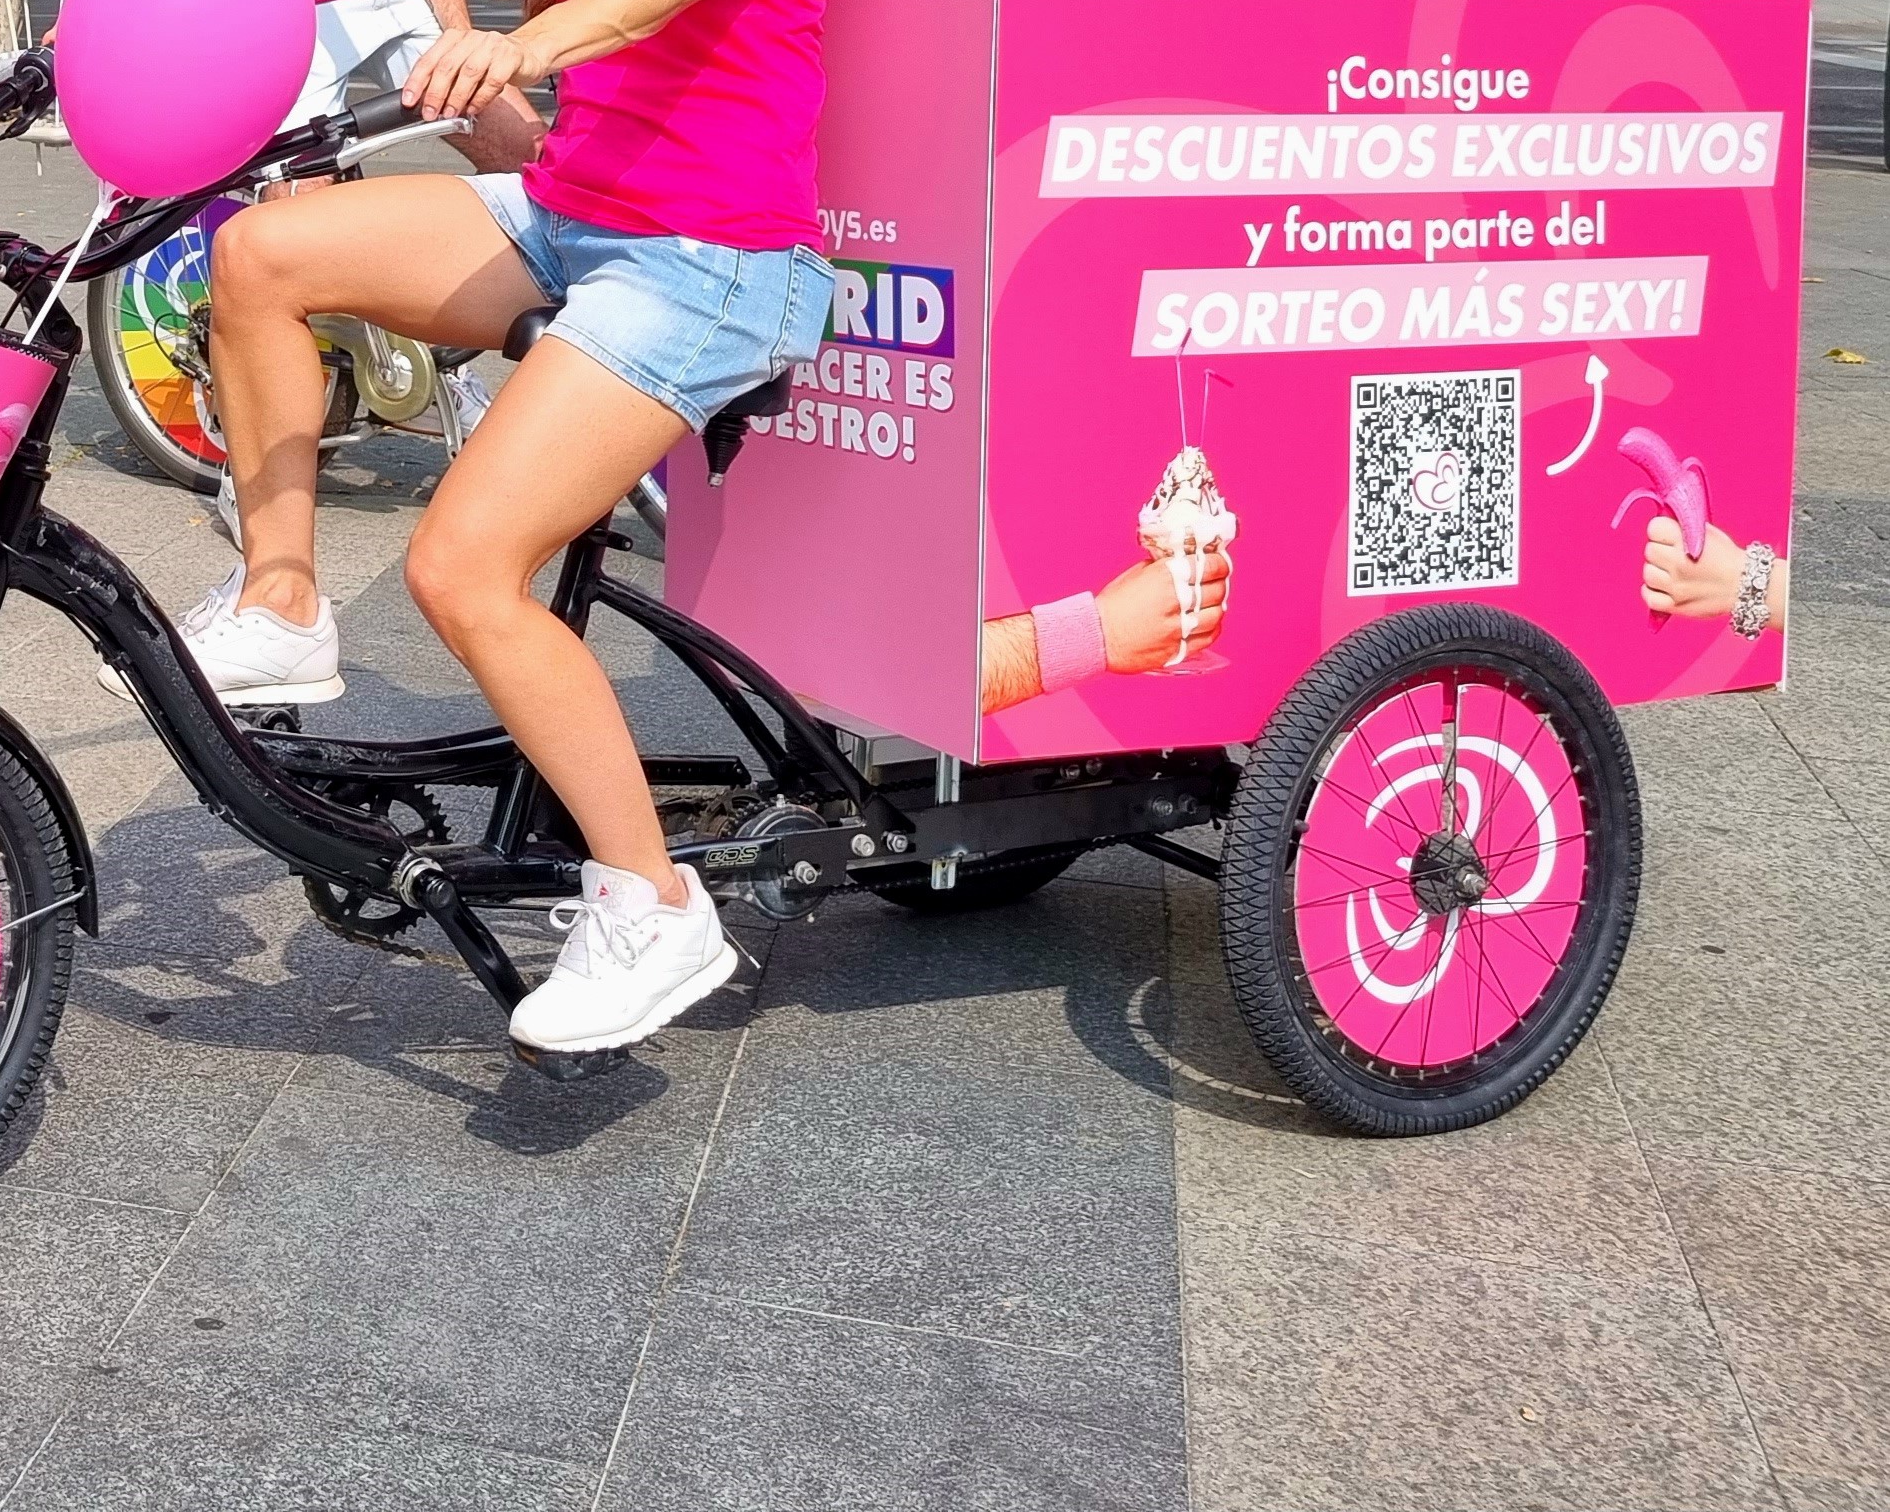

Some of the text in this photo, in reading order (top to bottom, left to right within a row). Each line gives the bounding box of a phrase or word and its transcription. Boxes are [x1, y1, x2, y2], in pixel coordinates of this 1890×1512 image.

[1326, 53, 1530, 113] ¡Consigue
[1050, 121, 1770, 183] DESCUENTOS EXCLUSIVOS
[1244, 200, 1606, 266] y forma parte del
[1150, 268, 1686, 350] SORTEO MÁS SEXY!
[905, 359, 954, 412] ES
